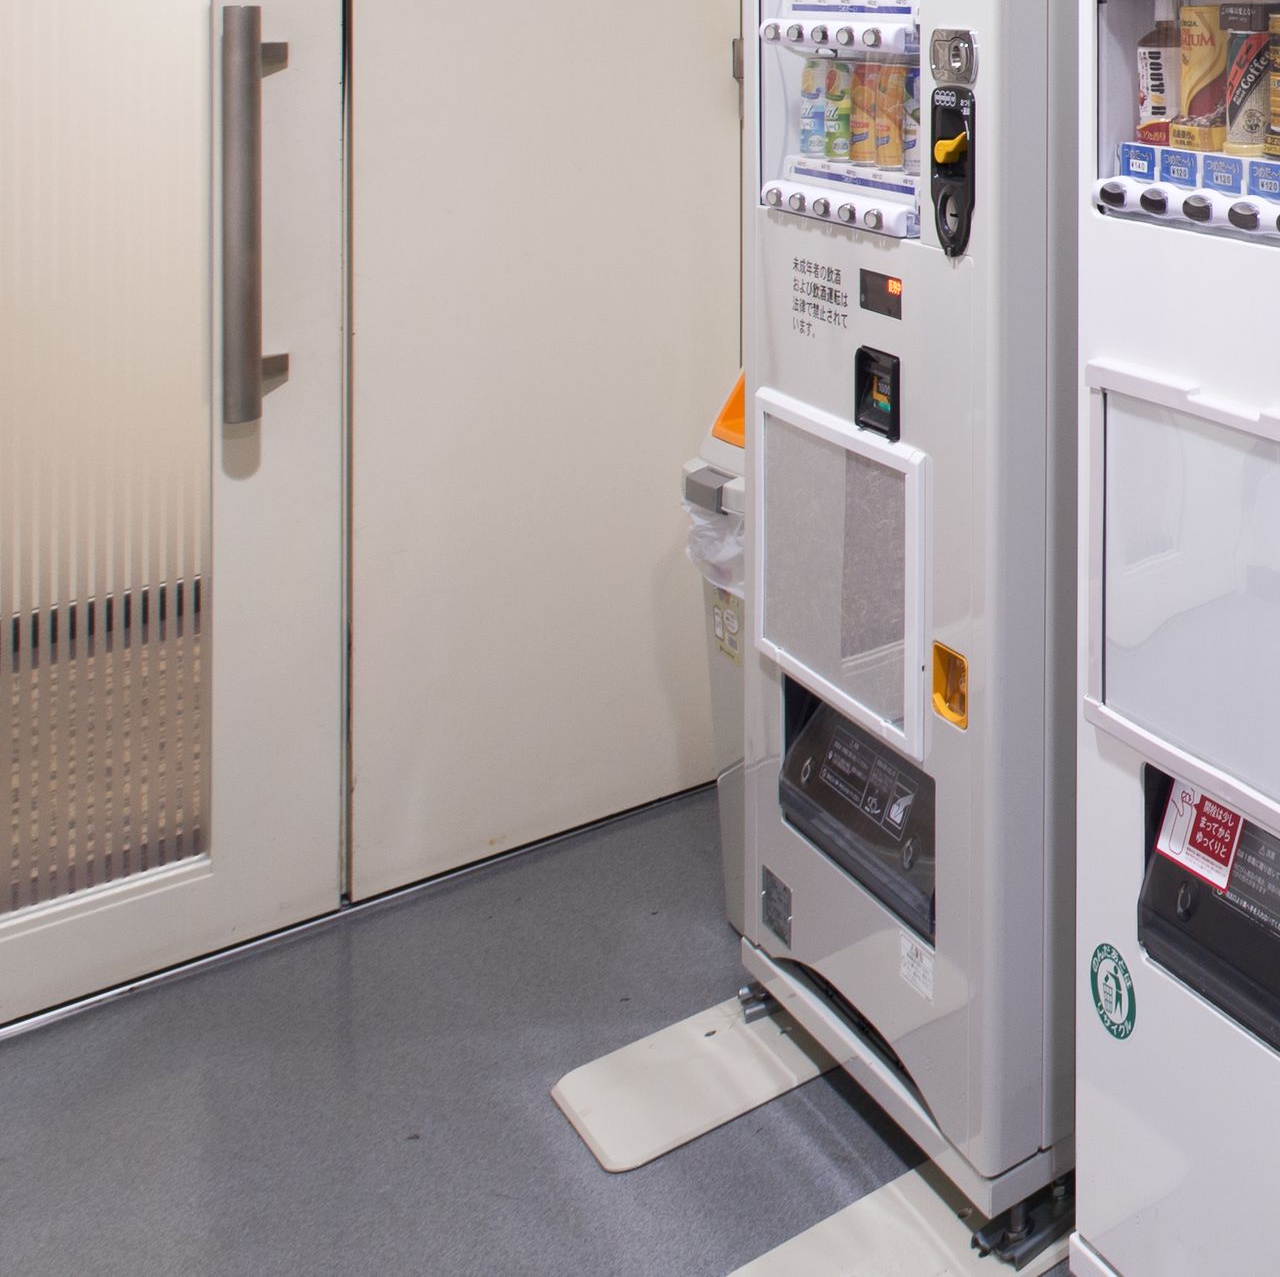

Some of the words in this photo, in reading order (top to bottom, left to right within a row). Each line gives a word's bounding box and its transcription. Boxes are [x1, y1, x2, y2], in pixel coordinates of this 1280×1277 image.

[792, 257, 842, 287] 未成年者の飲酒
[792, 277, 848, 308] および飲酒運転は
[792, 297, 848, 330] 法律で禁止されて
[1203, 800, 1234, 827] 開栓は少し
[1200, 816, 1231, 842] まってから
[1196, 831, 1228, 858] ゆっくりと
[1092, 945, 1133, 988] のんだあとは
